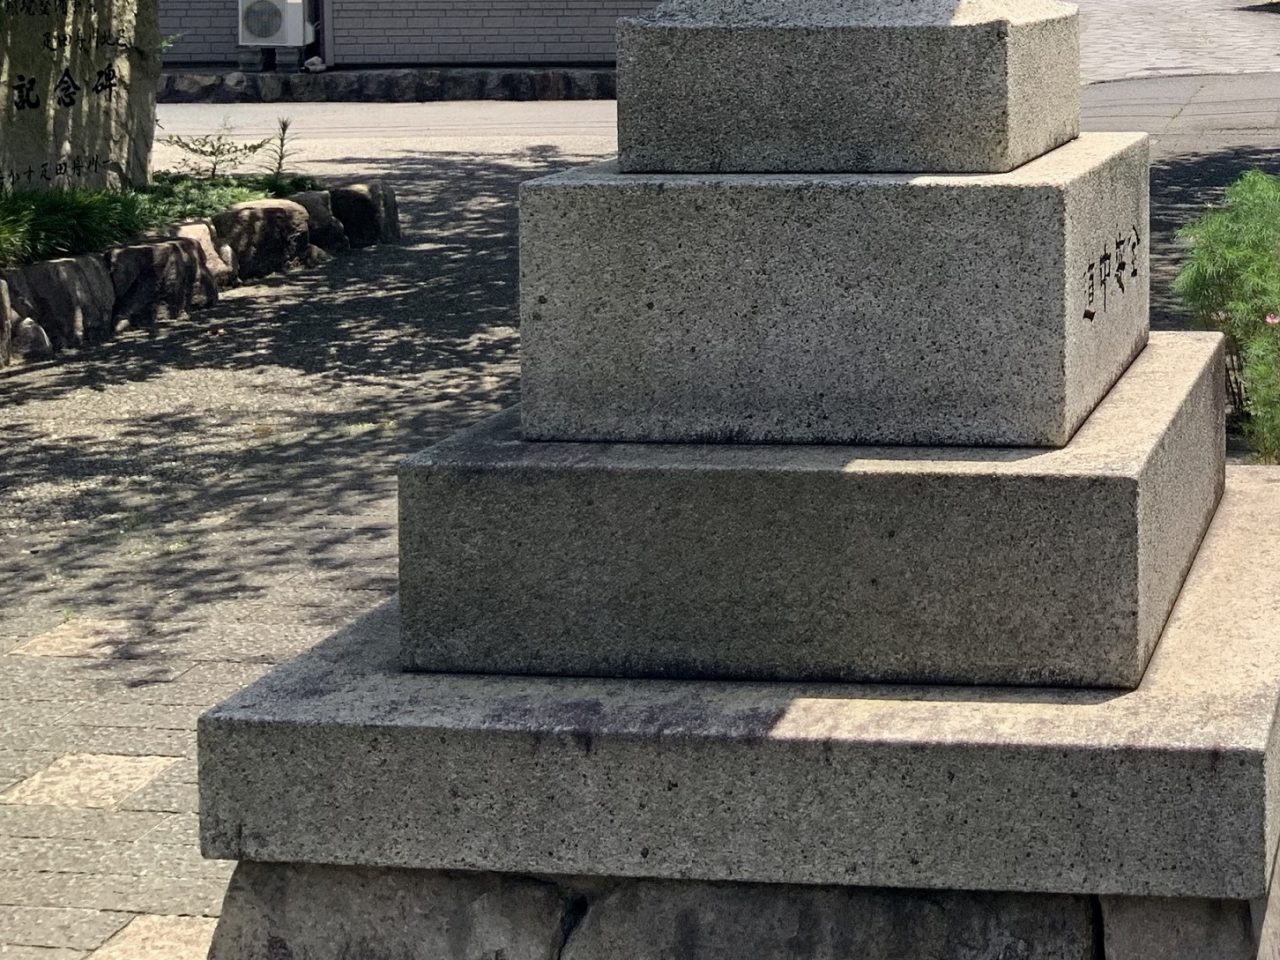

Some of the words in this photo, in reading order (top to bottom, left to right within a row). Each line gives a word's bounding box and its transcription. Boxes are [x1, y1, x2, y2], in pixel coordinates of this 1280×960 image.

[13, 63, 118, 110] 記念碑
[1083, 224, 1140, 322] 道中安全
